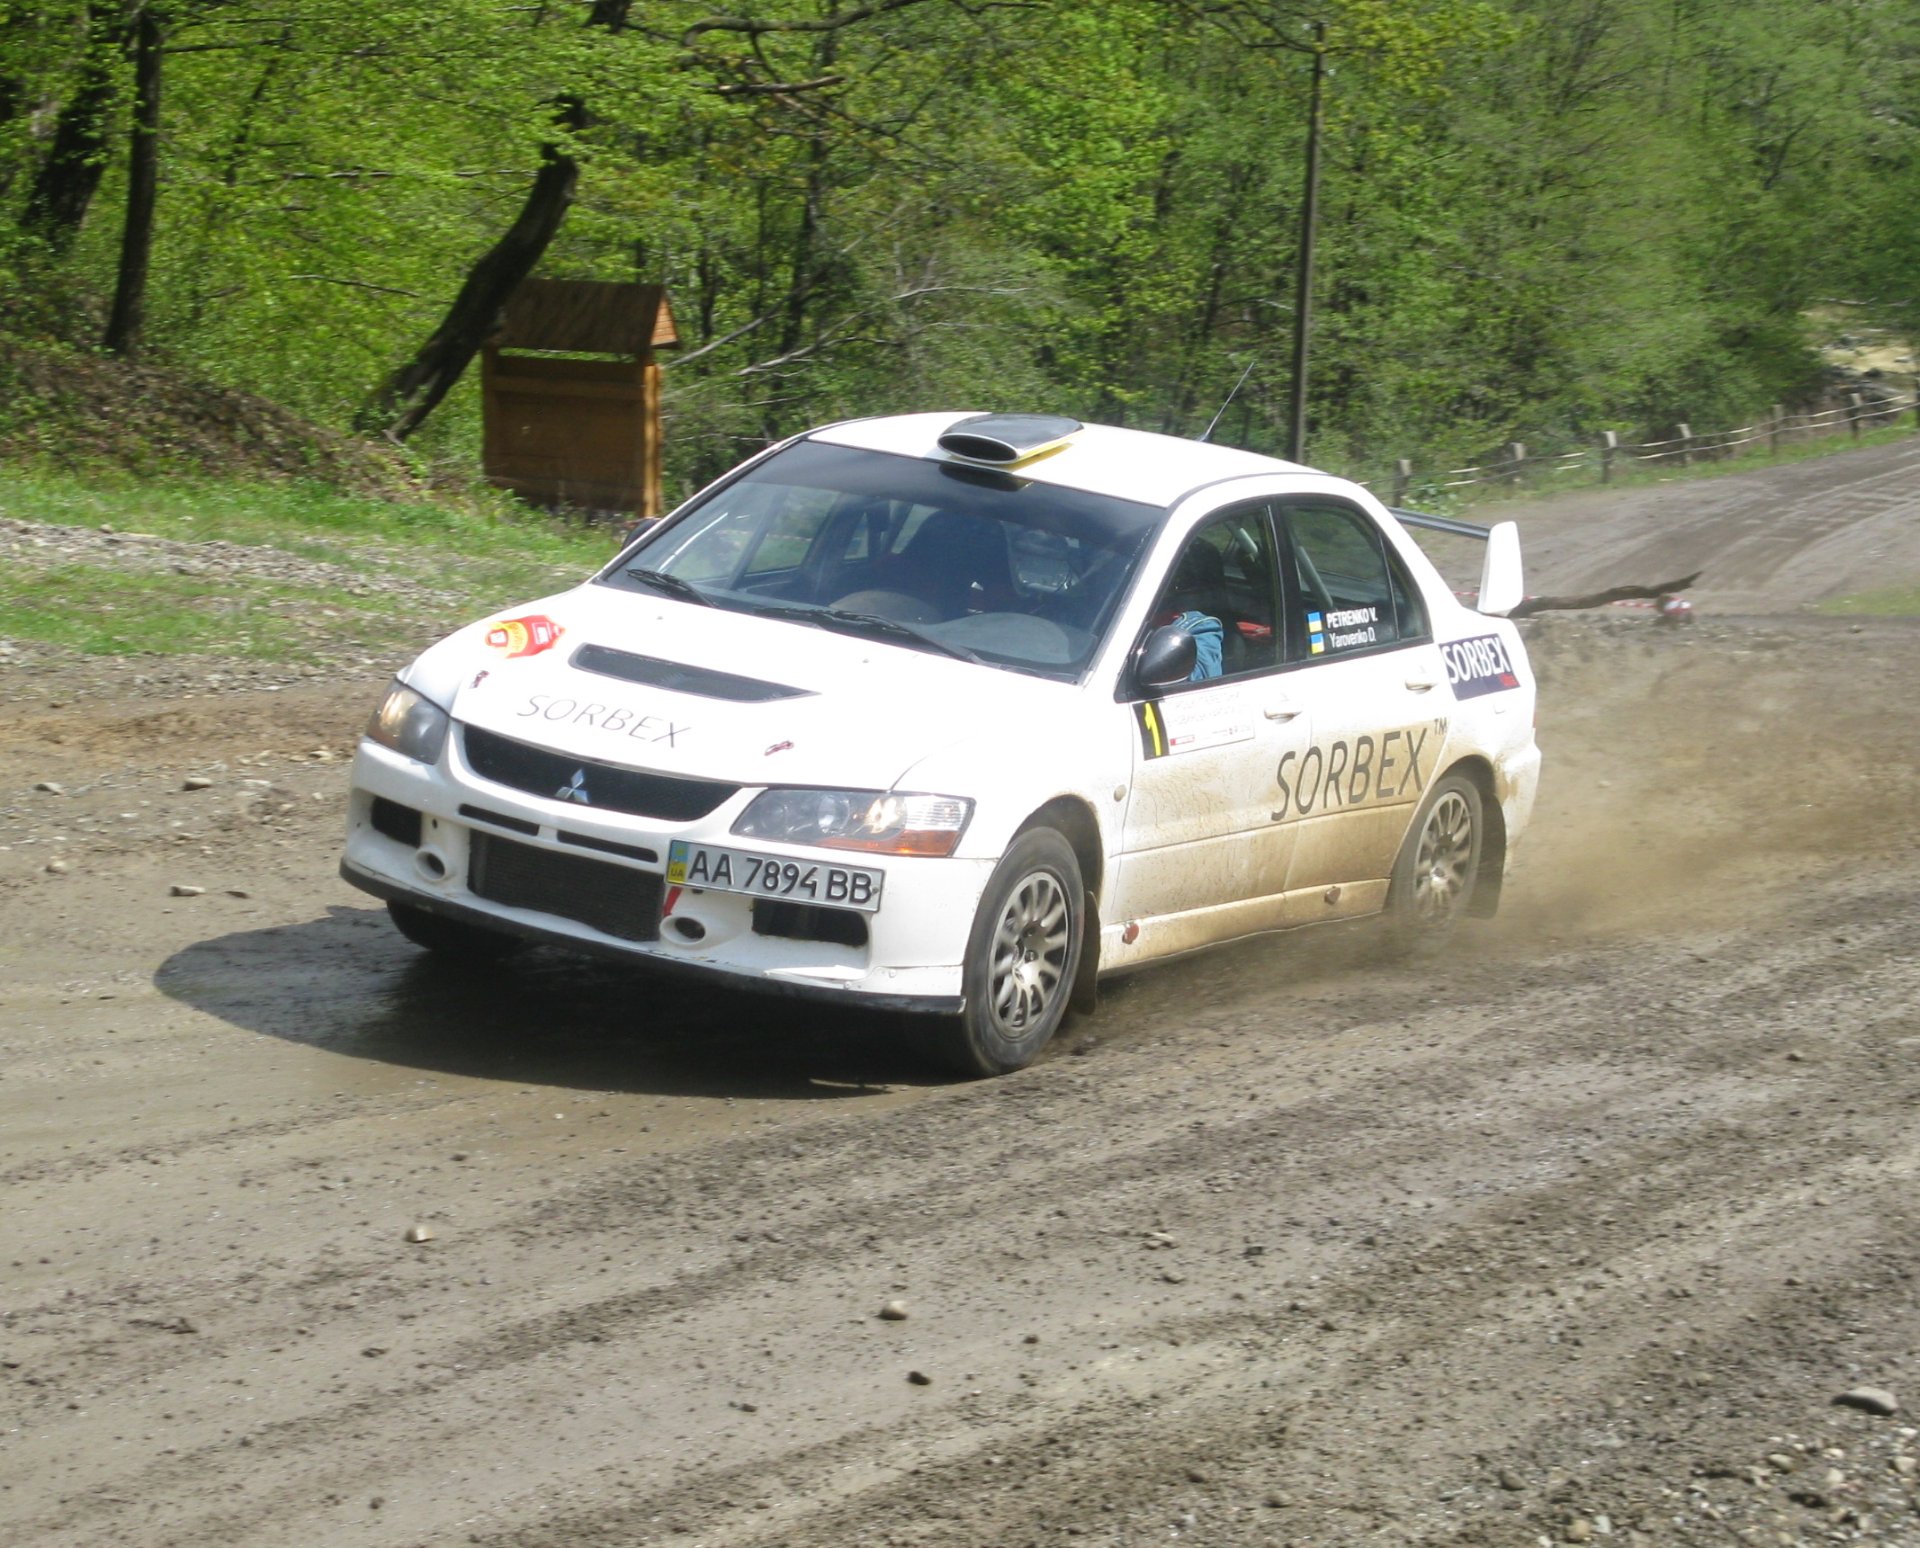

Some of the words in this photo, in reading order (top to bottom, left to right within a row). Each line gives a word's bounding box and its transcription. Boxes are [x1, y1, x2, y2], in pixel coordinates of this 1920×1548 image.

[1326, 608, 1369, 628] PETRENKO
[1368, 607, 1378, 621] V.
[1329, 629, 1367, 648] Yarovenko
[1442, 637, 1512, 684] SORBEX
[517, 695, 692, 748] SORBEX
[1145, 703, 1161, 755] 1
[1271, 728, 1427, 821] SORBEX
[671, 868, 684, 878] UA
[688, 850, 732, 885] AA
[745, 857, 818, 897] 7894
[825, 869, 872, 904] BB
